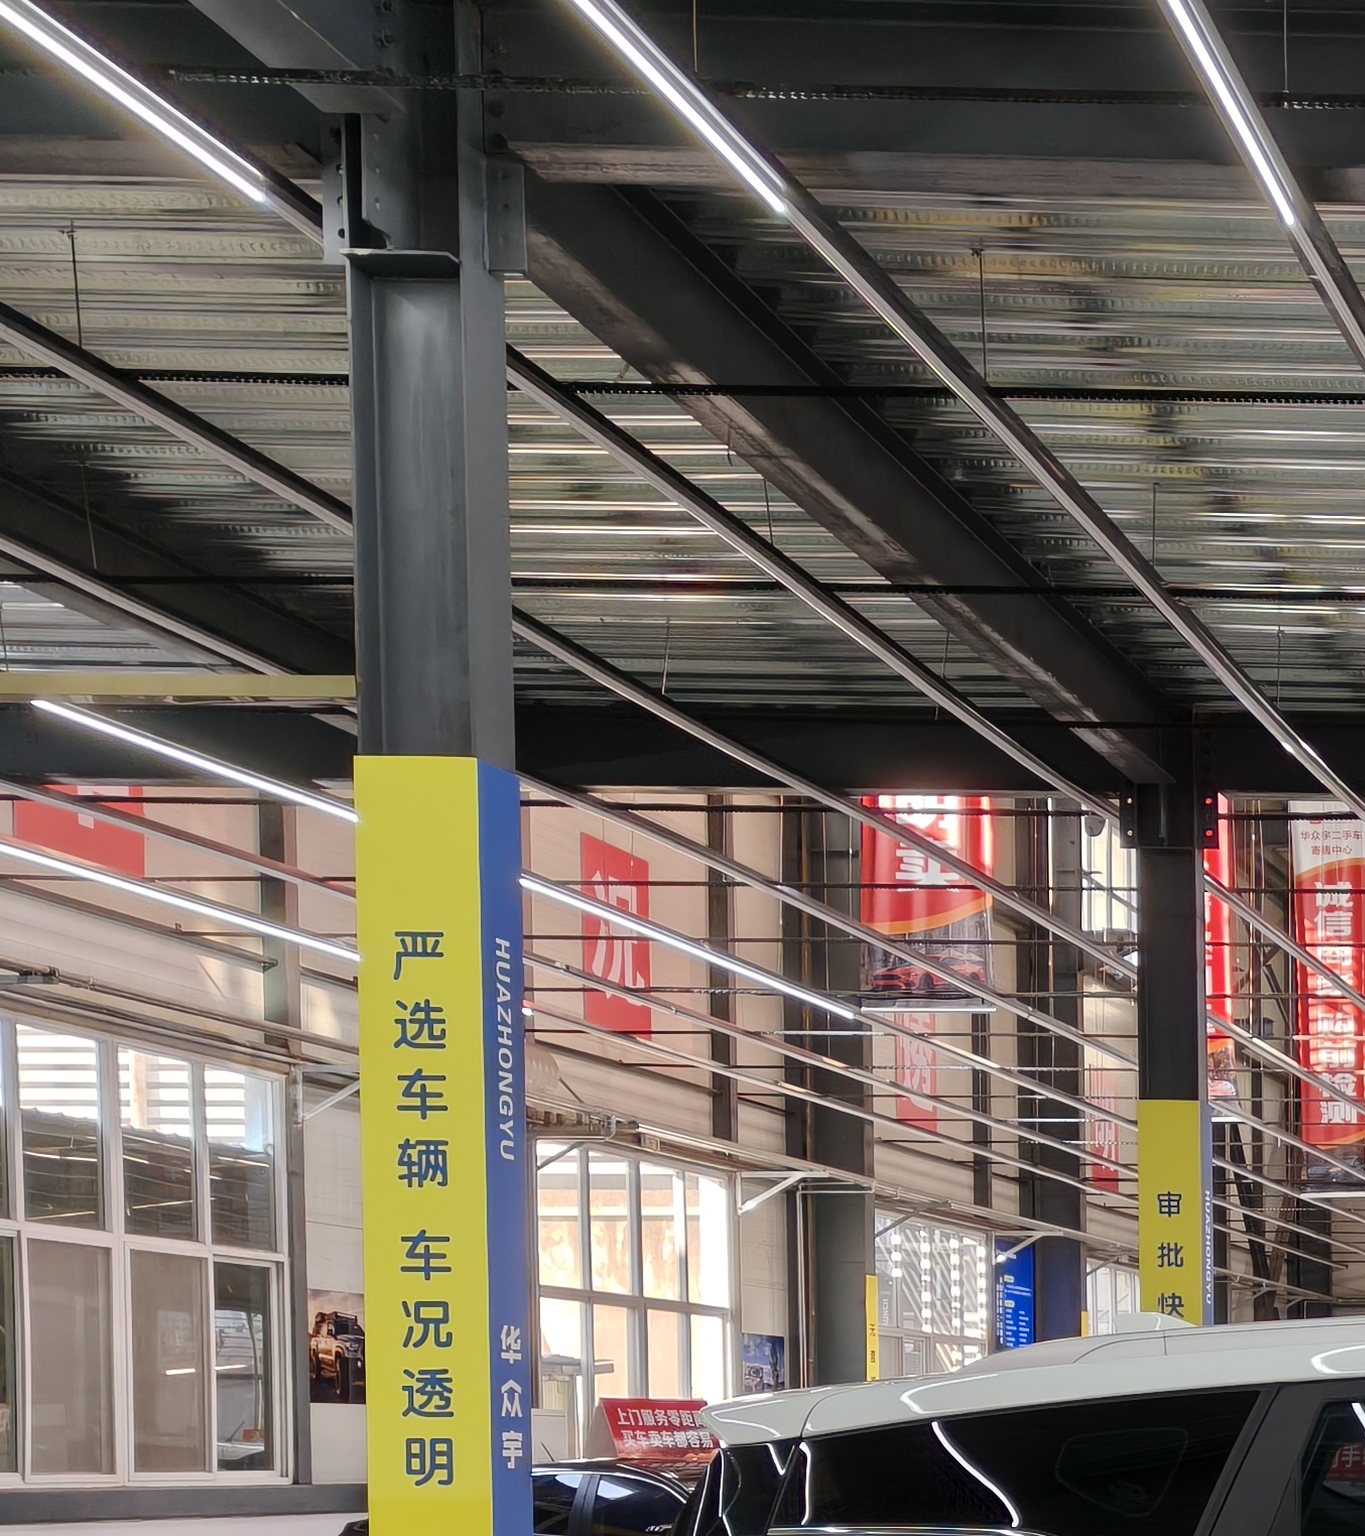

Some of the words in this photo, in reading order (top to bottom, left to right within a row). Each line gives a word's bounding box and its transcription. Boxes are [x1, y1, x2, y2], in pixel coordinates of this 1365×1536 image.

[1300, 829, 1363, 841] 华众宇二手车
[393, 930, 449, 1189] 严选车辆
[494, 936, 515, 1161] HUAZHONGYU
[1157, 1190, 1185, 1318] 审批快
[400, 1228, 455, 1487] 车况透明
[499, 1324, 523, 1470] 华众宇
